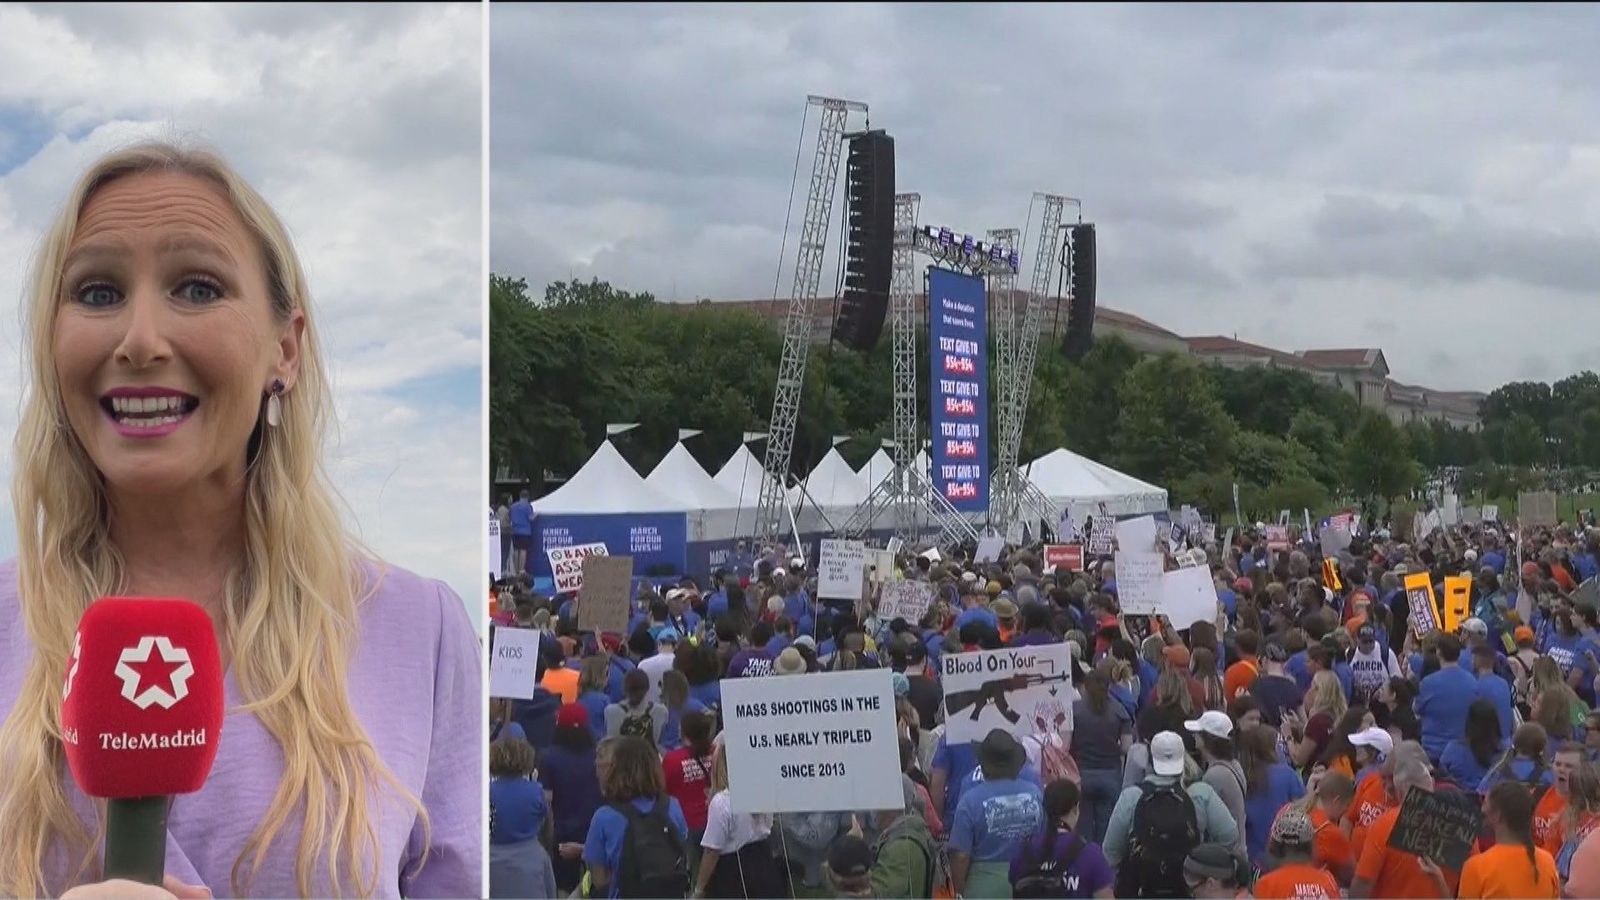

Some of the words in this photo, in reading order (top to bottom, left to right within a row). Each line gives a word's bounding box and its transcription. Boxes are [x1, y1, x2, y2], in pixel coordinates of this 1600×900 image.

[940, 336, 955, 351] TEXT
[955, 339, 970, 354] GIVE
[970, 342, 978, 355] TO
[940, 380, 955, 393] TEXT
[956, 382, 970, 395] GIVE
[971, 383, 979, 397] TO
[941, 423, 956, 436] TEXT
[956, 424, 971, 437] GIVE
[971, 425, 979, 438] TO
[941, 465, 957, 479] TEXT
[957, 465, 971, 479] GIVE
[971, 466, 980, 479] TO
[543, 528, 569, 536] MARCH
[631, 527, 657, 535] MARCH
[499, 645, 523, 659] KIDS
[748, 658, 772, 670] TAKE
[945, 655, 982, 675] Blood
[987, 654, 1007, 671] On
[1009, 651, 1036, 668] Your
[1353, 660, 1383, 671] MARCH
[736, 703, 768, 718] MASS
[771, 699, 838, 716] SHOOTINGS
[841, 698, 854, 712] IN
[856, 696, 881, 710] THE
[99, 728, 206, 750] TeleMadrid
[749, 735, 772, 748] U.S.
[775, 731, 819, 747] NEARLY
[823, 729, 872, 745] TRIPLED
[781, 763, 815, 778] SINCE
[818, 762, 846, 777] 2013
